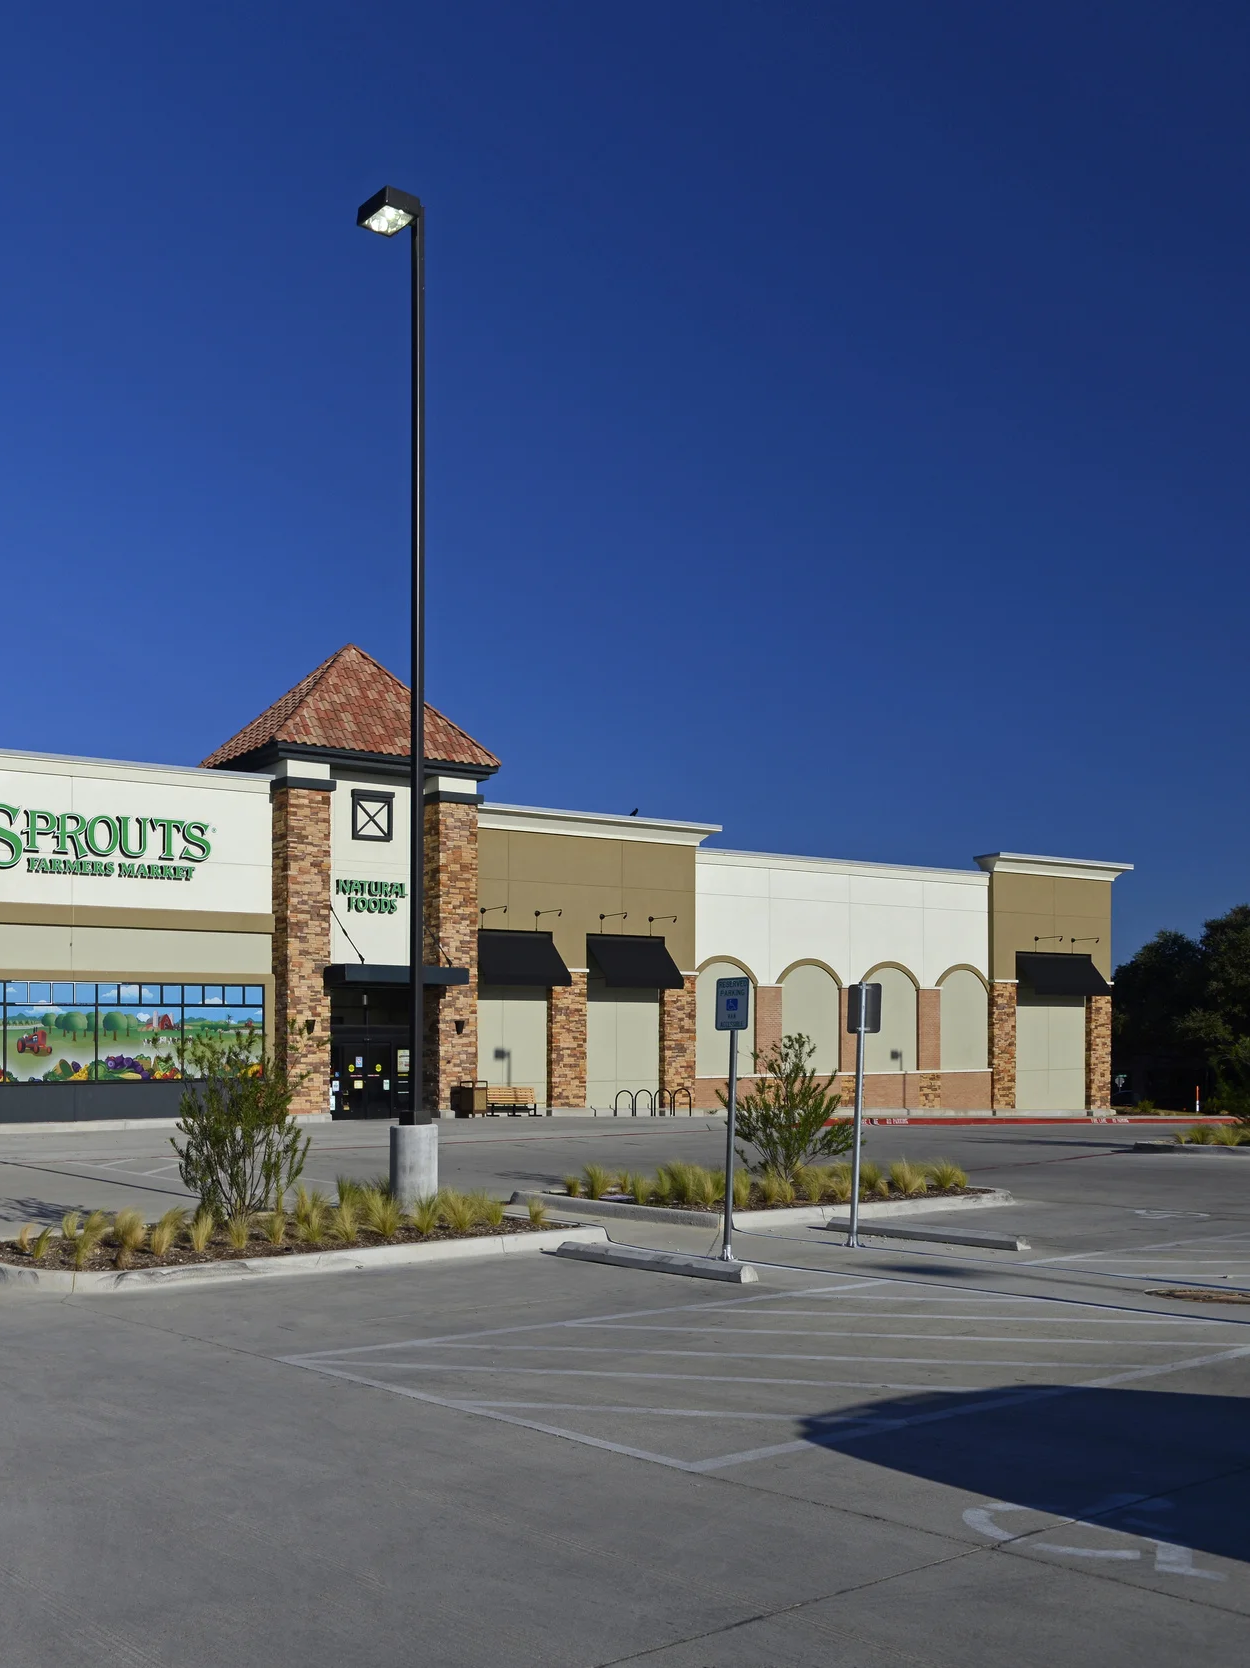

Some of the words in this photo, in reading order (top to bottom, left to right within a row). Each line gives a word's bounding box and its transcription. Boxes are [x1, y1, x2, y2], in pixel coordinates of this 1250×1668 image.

[27, 857, 115, 877] FARMERS
[118, 862, 195, 881] MARKET
[335, 879, 408, 898] NATURAL
[347, 897, 398, 914] FOODS
